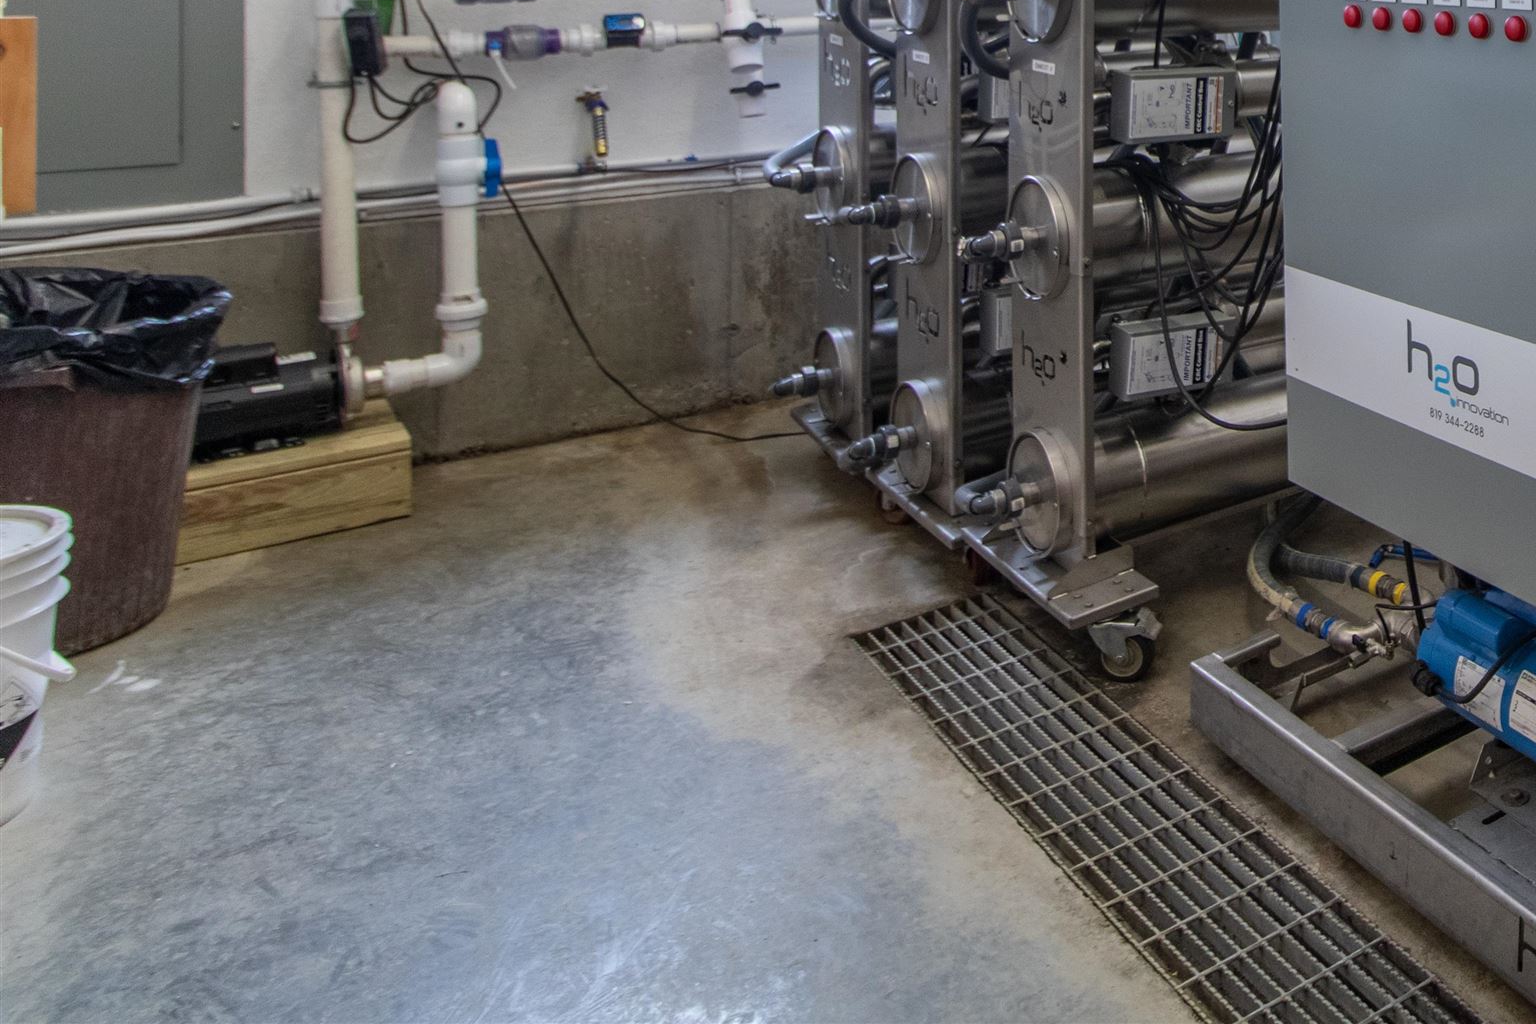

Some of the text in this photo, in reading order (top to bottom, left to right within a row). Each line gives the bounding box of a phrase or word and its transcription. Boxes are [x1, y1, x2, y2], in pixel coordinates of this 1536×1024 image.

[1185, 83, 1193, 129] IMPORTANT
[1184, 336, 1193, 381] IMPORTANT
[1429, 407, 1485, 438] 819 344-2288
[1456, 396, 1509, 426] innovation
